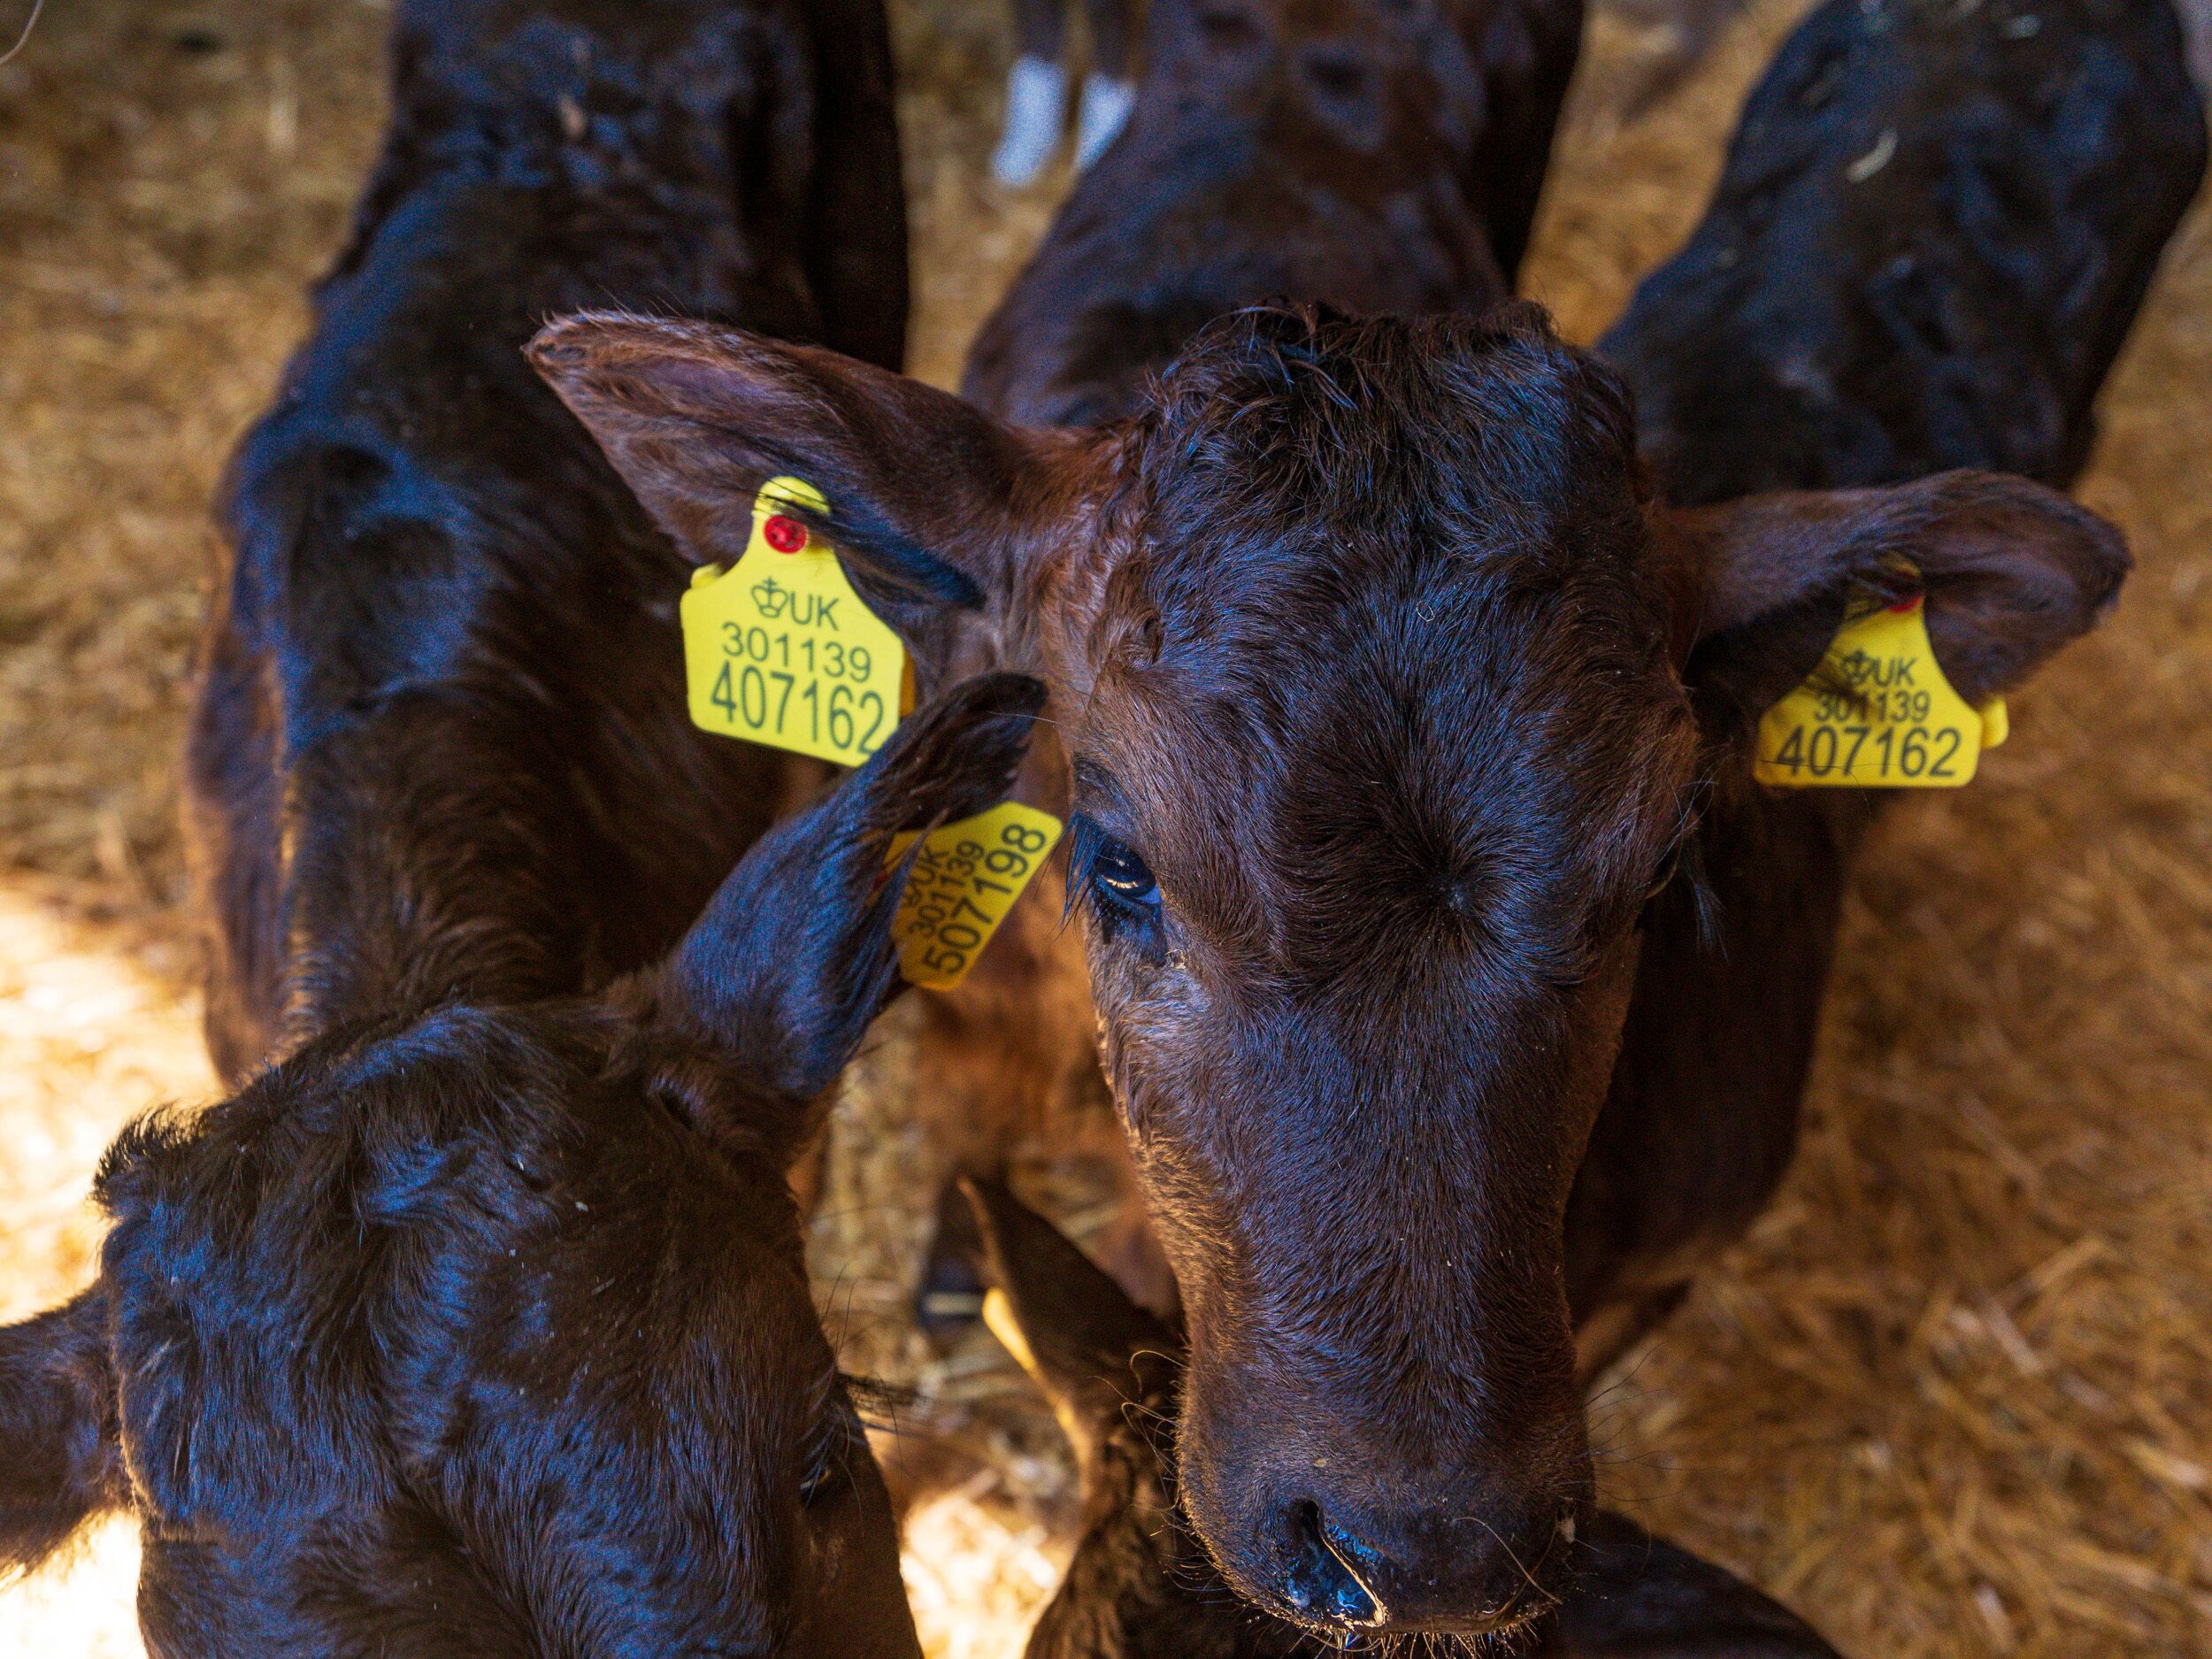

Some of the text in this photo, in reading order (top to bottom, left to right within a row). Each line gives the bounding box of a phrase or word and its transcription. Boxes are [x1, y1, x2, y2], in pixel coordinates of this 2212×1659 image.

[789, 591, 839, 631] UK
[723, 621, 871, 682] 301139
[1871, 657, 1918, 688] UK
[711, 659, 883, 754] 407162
[1777, 726, 1962, 779] 407162
[909, 840, 985, 938] 301139
[922, 824, 1046, 974] 507198
